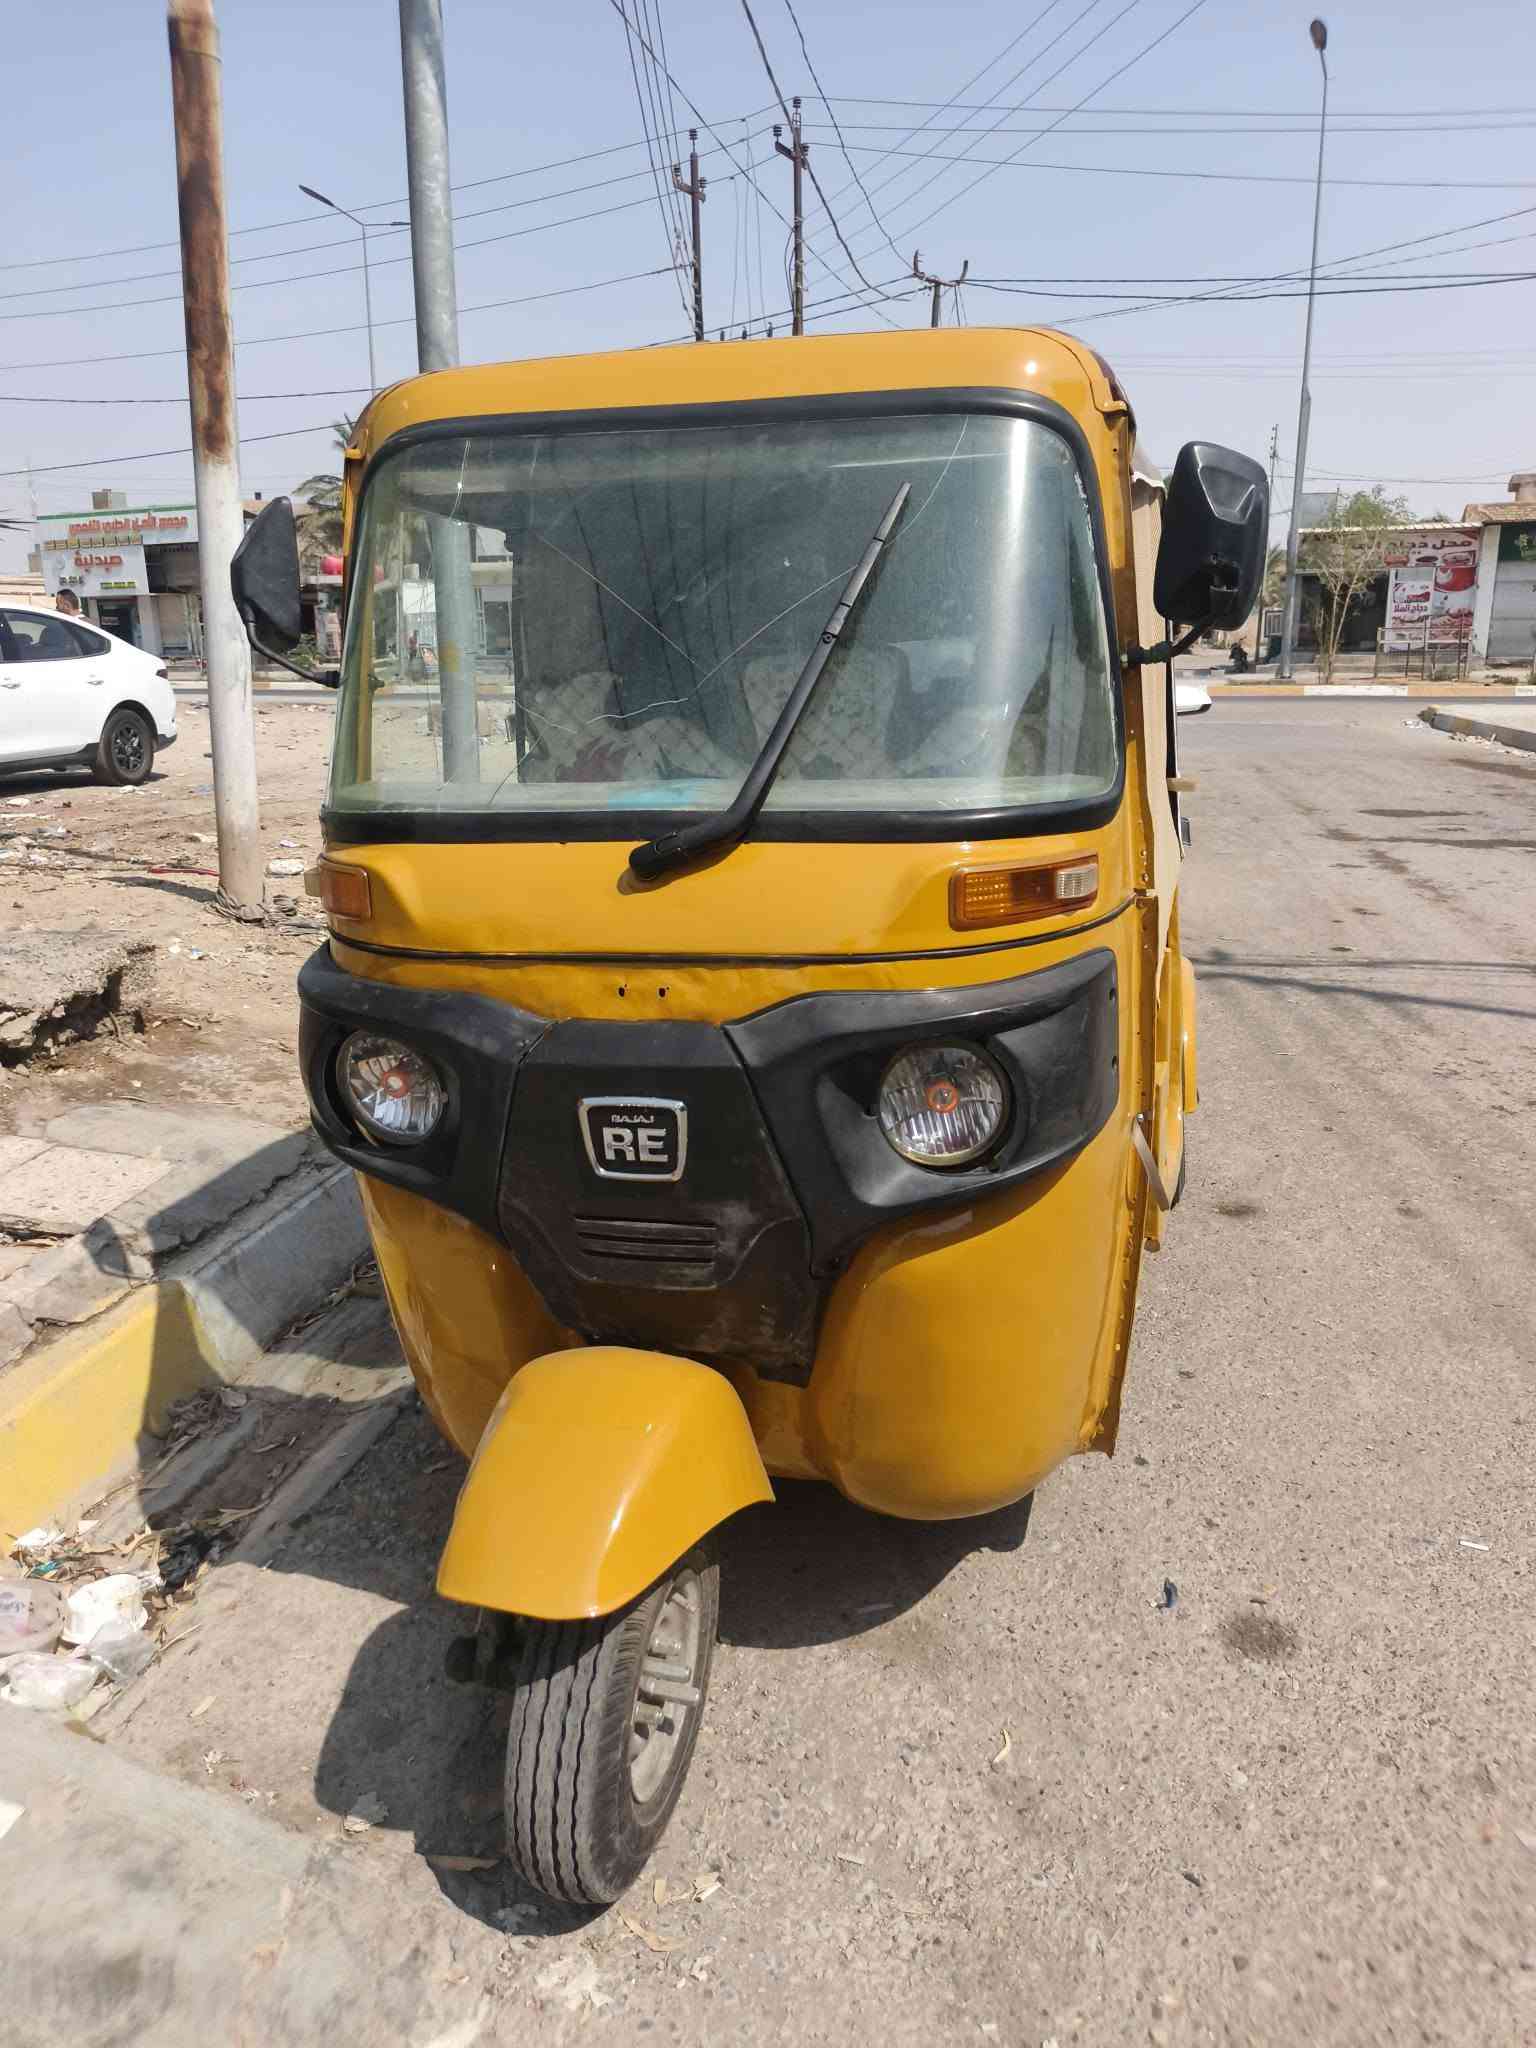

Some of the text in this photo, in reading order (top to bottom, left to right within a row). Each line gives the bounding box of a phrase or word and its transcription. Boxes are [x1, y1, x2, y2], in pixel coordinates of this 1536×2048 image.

[1432, 539, 1473, 550] محل
[74, 550, 123, 573] صيدلية
[611, 1114, 655, 1124] BAJAJ
[602, 1127, 668, 1162] RE
